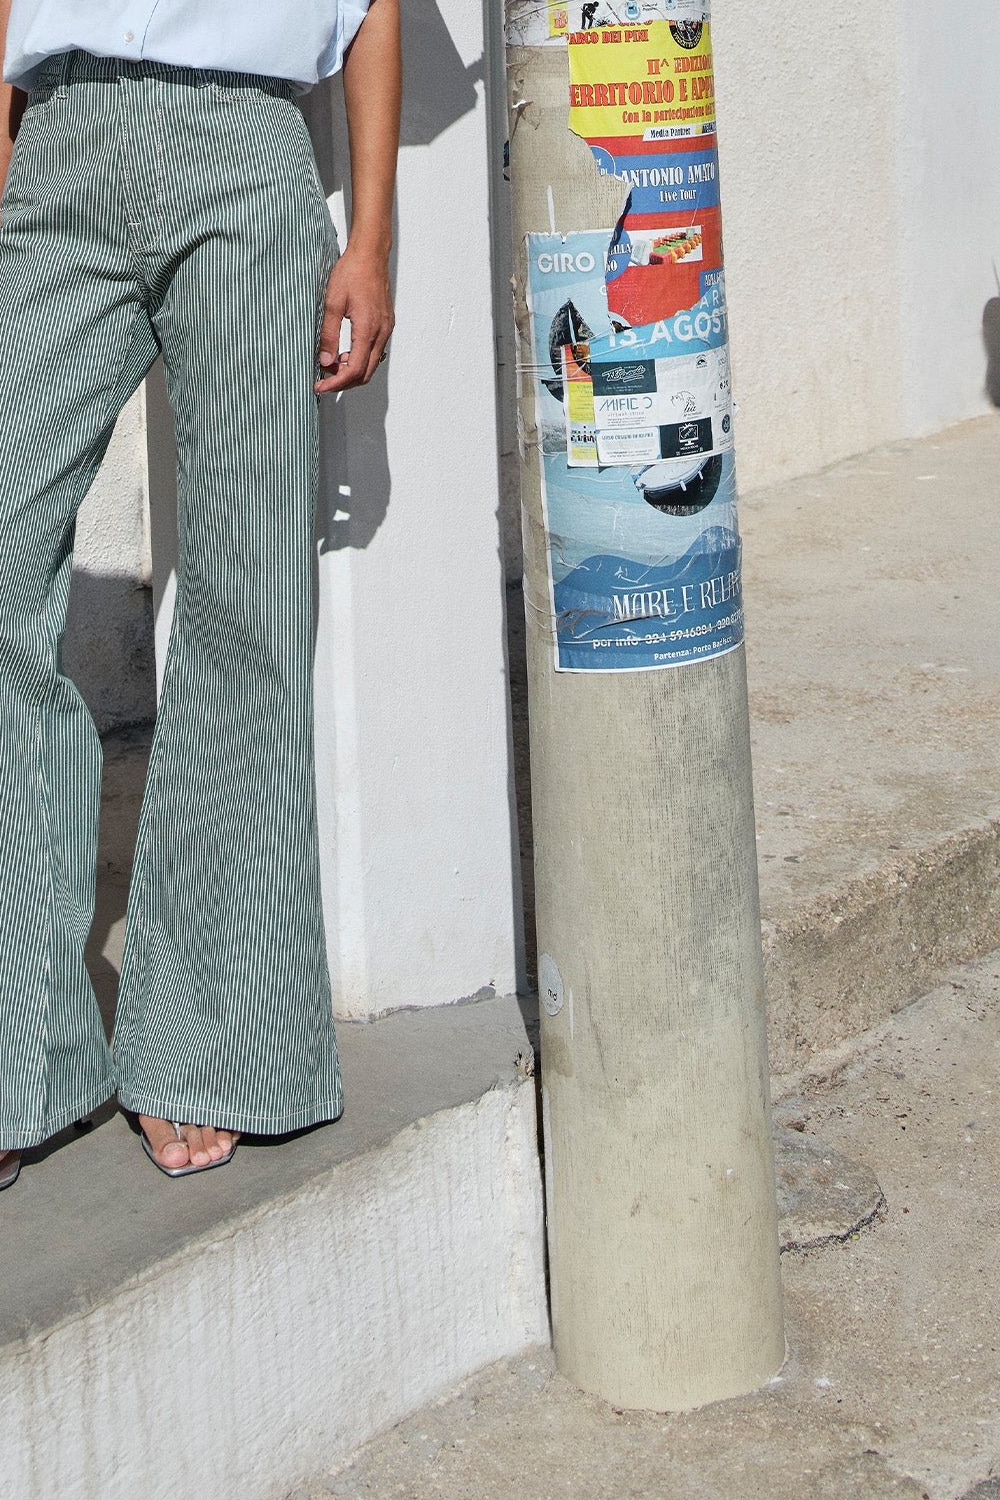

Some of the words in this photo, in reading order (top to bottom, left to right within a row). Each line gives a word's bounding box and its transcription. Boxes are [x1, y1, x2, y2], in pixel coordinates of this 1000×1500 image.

[601, 31, 623, 44] DEI
[624, 29, 650, 43] PINI
[678, 78, 688, 102] E
[622, 110, 640, 124] Con
[641, 109, 652, 123] la
[653, 106, 705, 124] partecipazione
[650, 127, 669, 138] Media
[670, 126, 691, 137] Partner
[620, 166, 684, 188] ANTONIO
[687, 162, 715, 184] AMATO
[659, 190, 678, 203] Live
[680, 189, 697, 201] Tour
[612, 588, 677, 620] MARE
[681, 583, 696, 613] E
[592, 638, 613, 649] per
[654, 646, 693, 661] Partenza:
[693, 643, 712, 654] Porto
